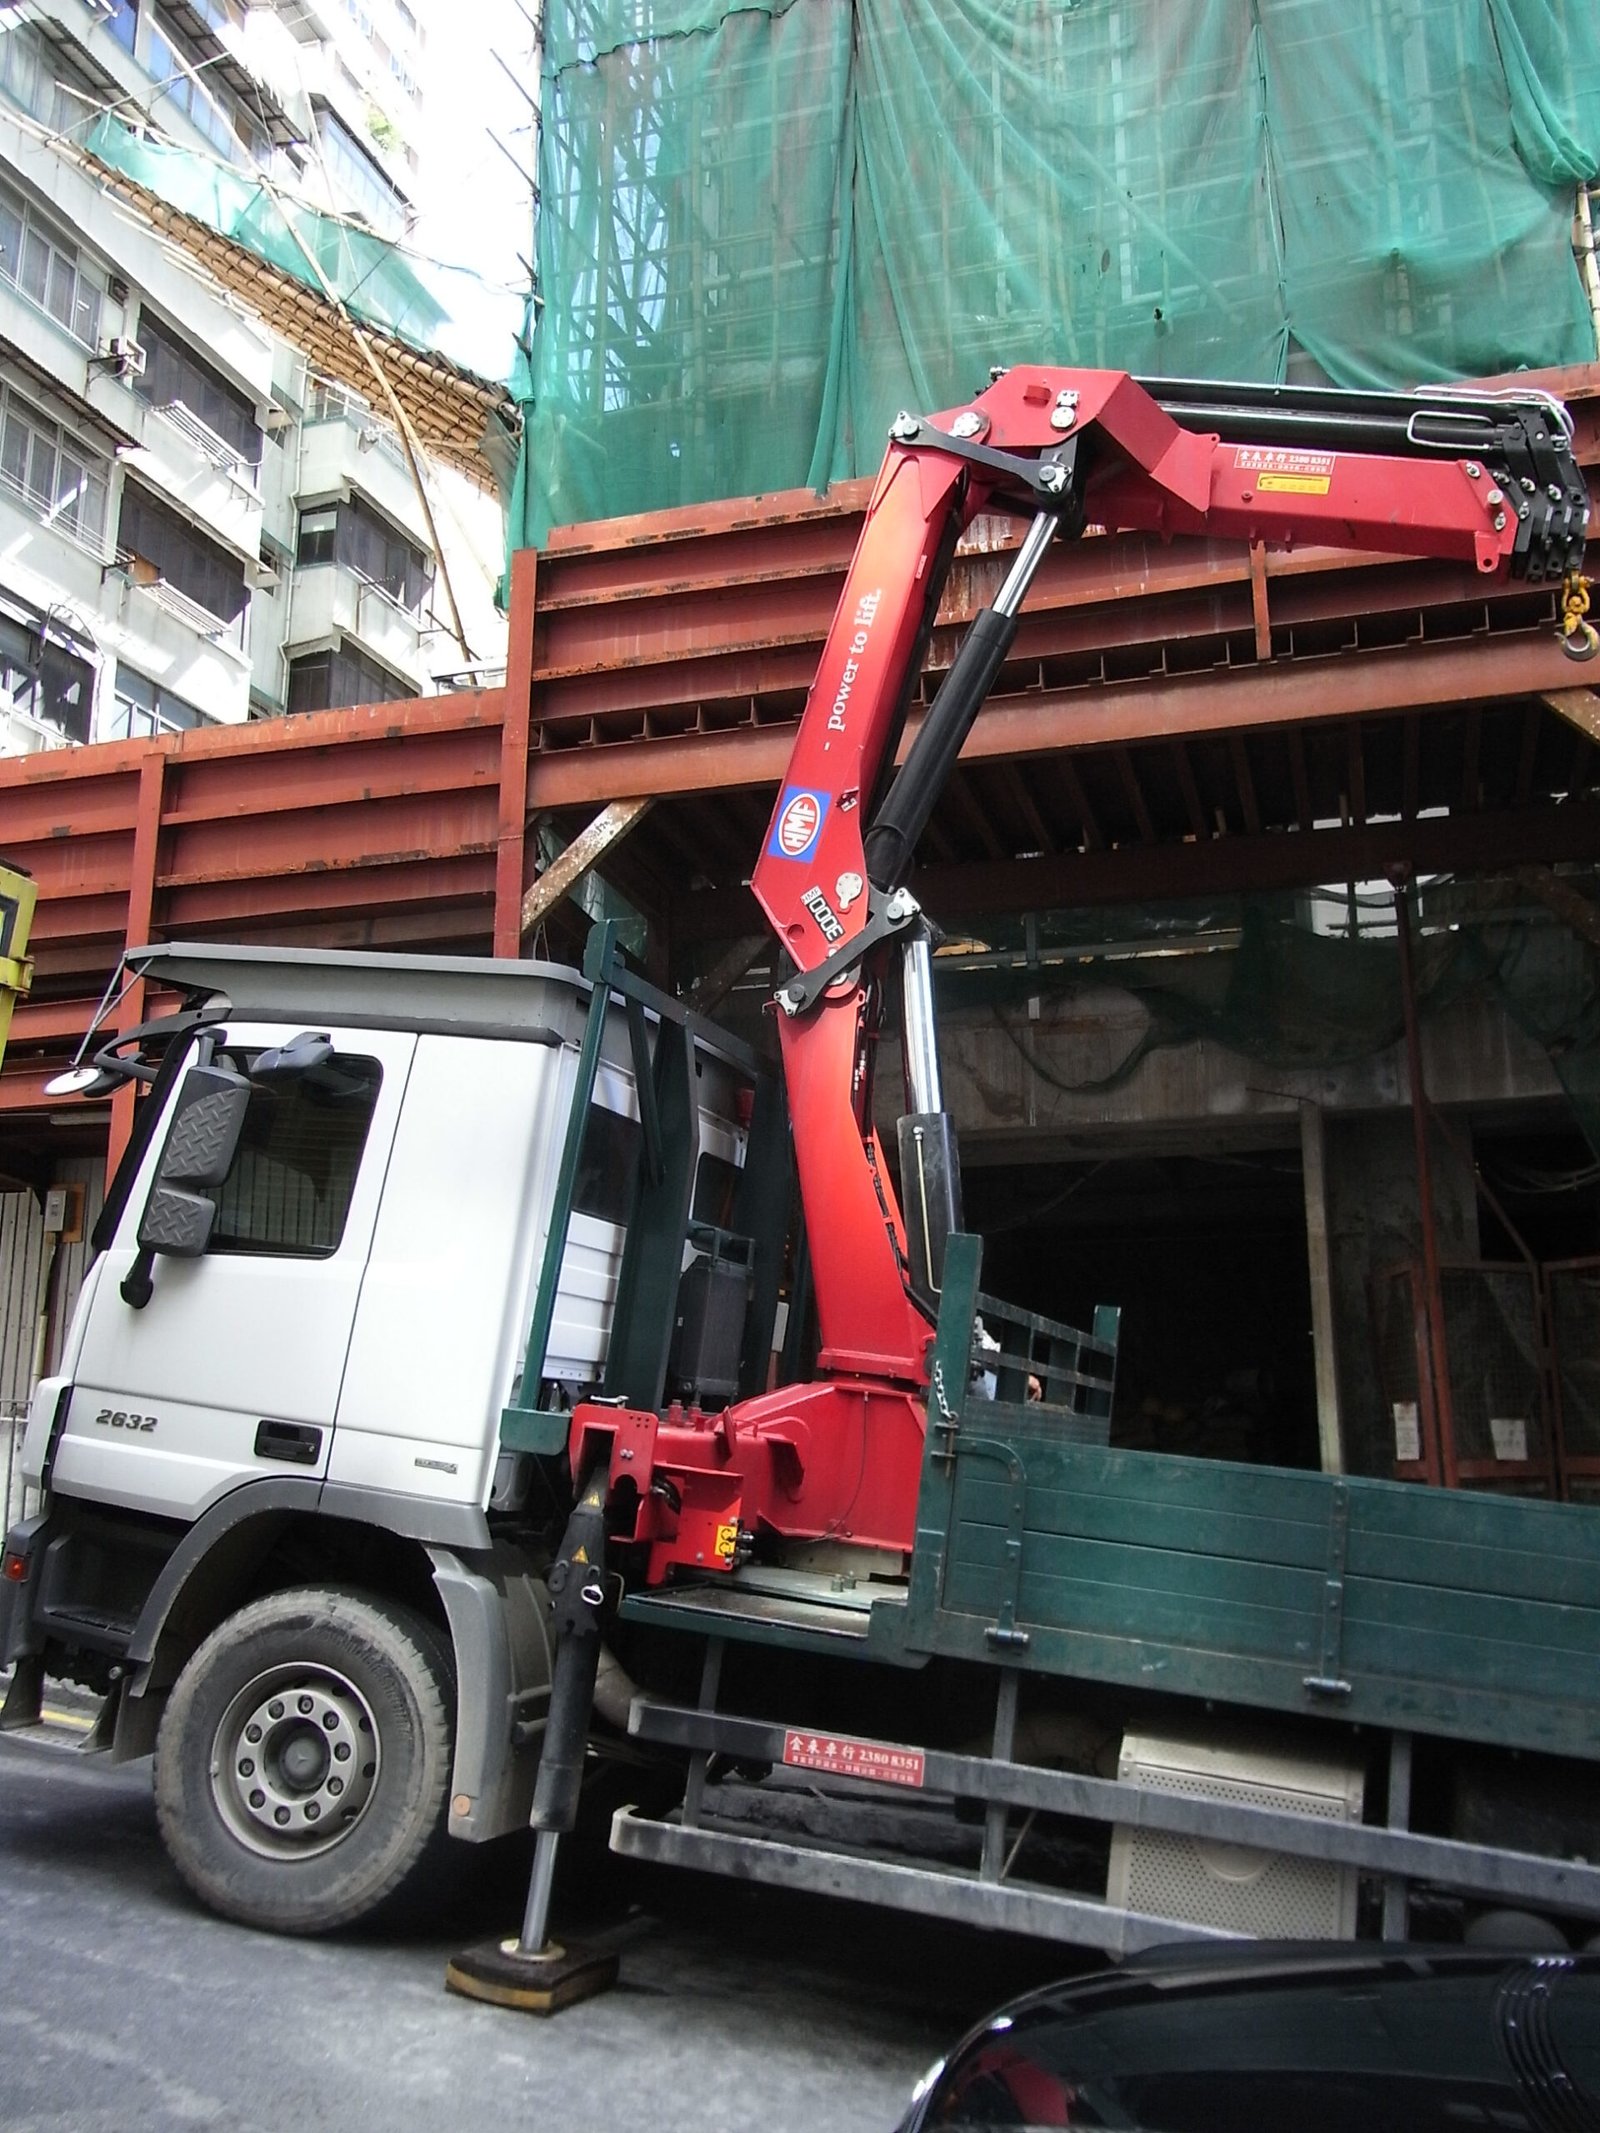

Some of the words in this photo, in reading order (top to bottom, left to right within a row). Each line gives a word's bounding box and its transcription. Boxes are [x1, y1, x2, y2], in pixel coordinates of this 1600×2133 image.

[827, 658, 860, 733] power
[849, 631, 868, 655] to
[783, 800, 816, 849] HMF
[95, 1409, 158, 1432] 2632
[859, 1749, 889, 1765] 2380
[890, 1754, 919, 1771] 8351
